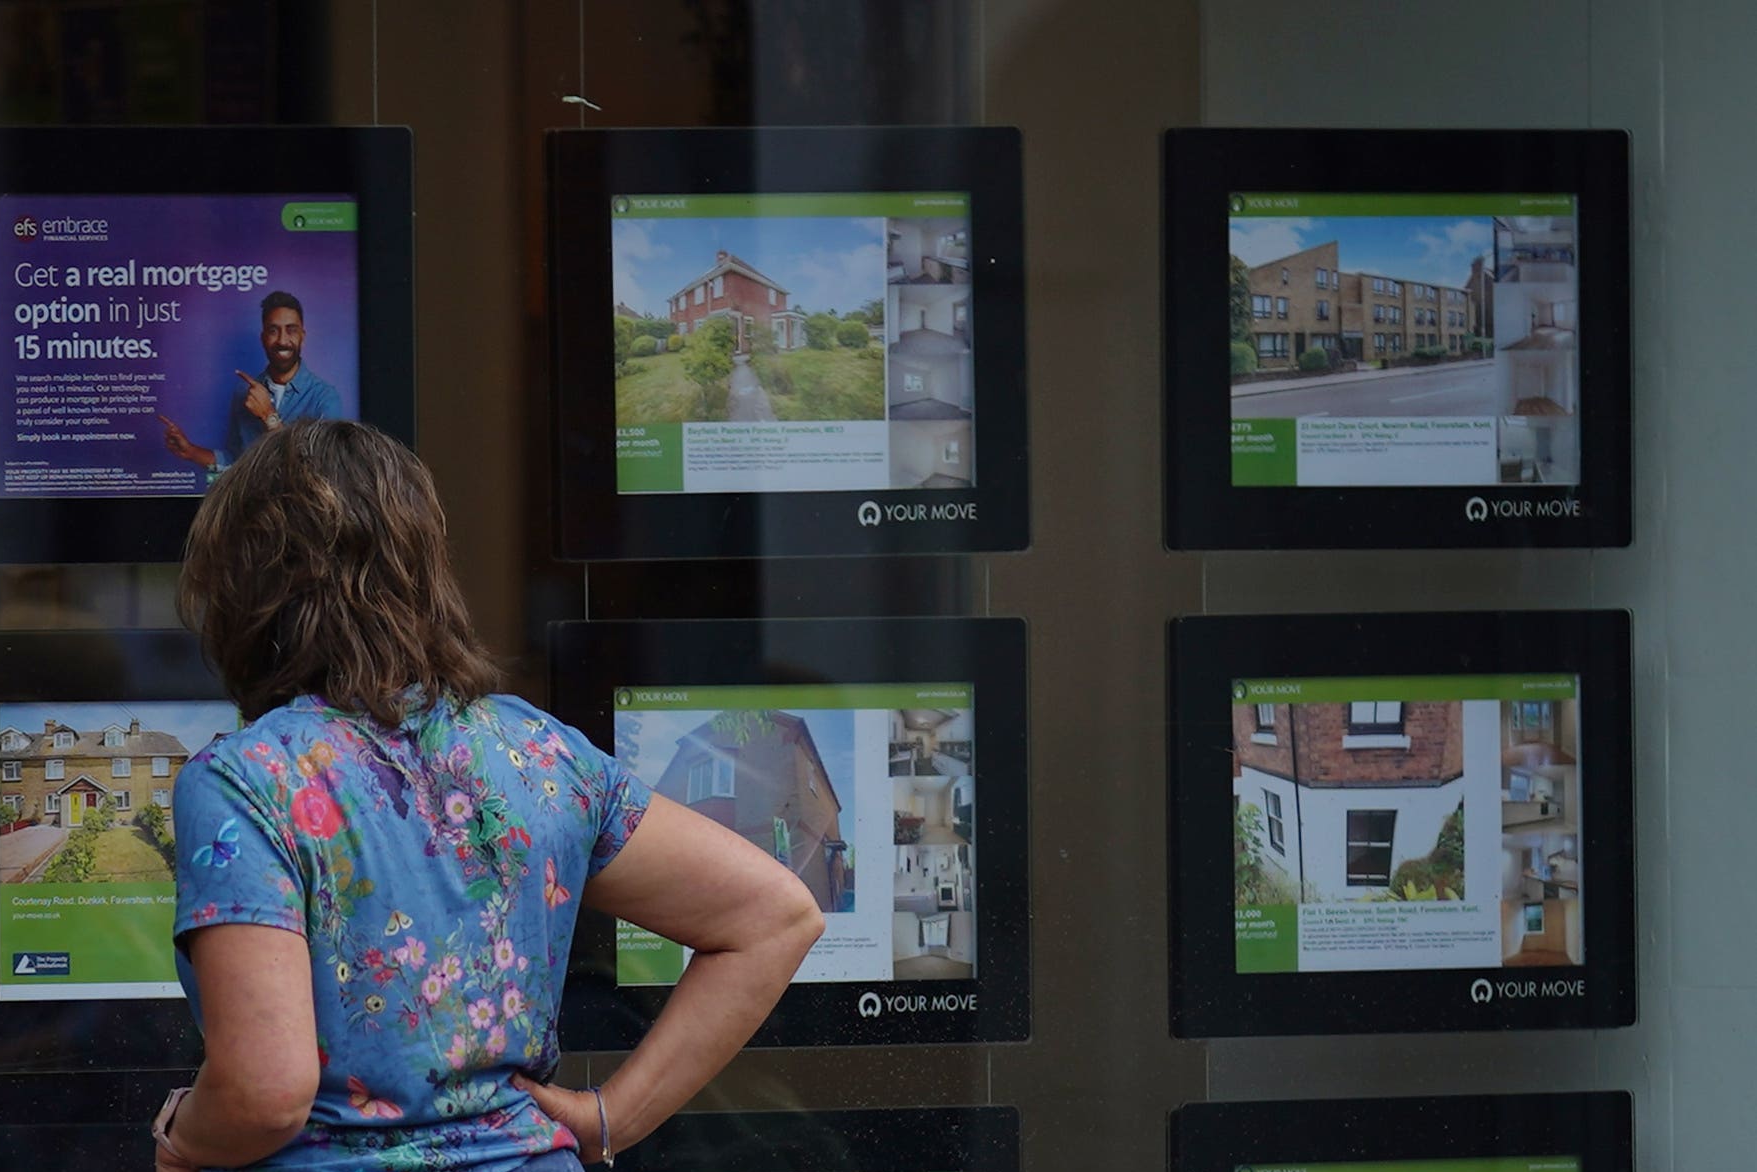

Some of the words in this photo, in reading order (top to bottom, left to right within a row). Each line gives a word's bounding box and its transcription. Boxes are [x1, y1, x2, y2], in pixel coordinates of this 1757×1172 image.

[14, 218, 37, 236] efs
[42, 216, 108, 234] embrace
[15, 263, 59, 287] Get
[65, 266, 80, 287] a
[87, 259, 135, 287] real
[142, 262, 268, 292] mortgage
[15, 296, 101, 330] option
[109, 297, 129, 322] in
[136, 297, 181, 329] just
[15, 335, 41, 360] 15
[47, 332, 158, 360] minutes.
[884, 504, 927, 522] YOUR
[931, 503, 977, 520] MOVE
[1491, 500, 1533, 518] YOUR
[1537, 500, 1581, 516] MOVE
[636, 692, 661, 702] YOUR
[663, 692, 688, 702] MOVE
[1251, 684, 1273, 694] YOUR
[1276, 684, 1301, 694] MOVE
[1497, 981, 1537, 998] YOUR
[1542, 980, 1585, 997] MOVE
[885, 994, 927, 1012] YOUR
[931, 994, 977, 1011] MOVE
